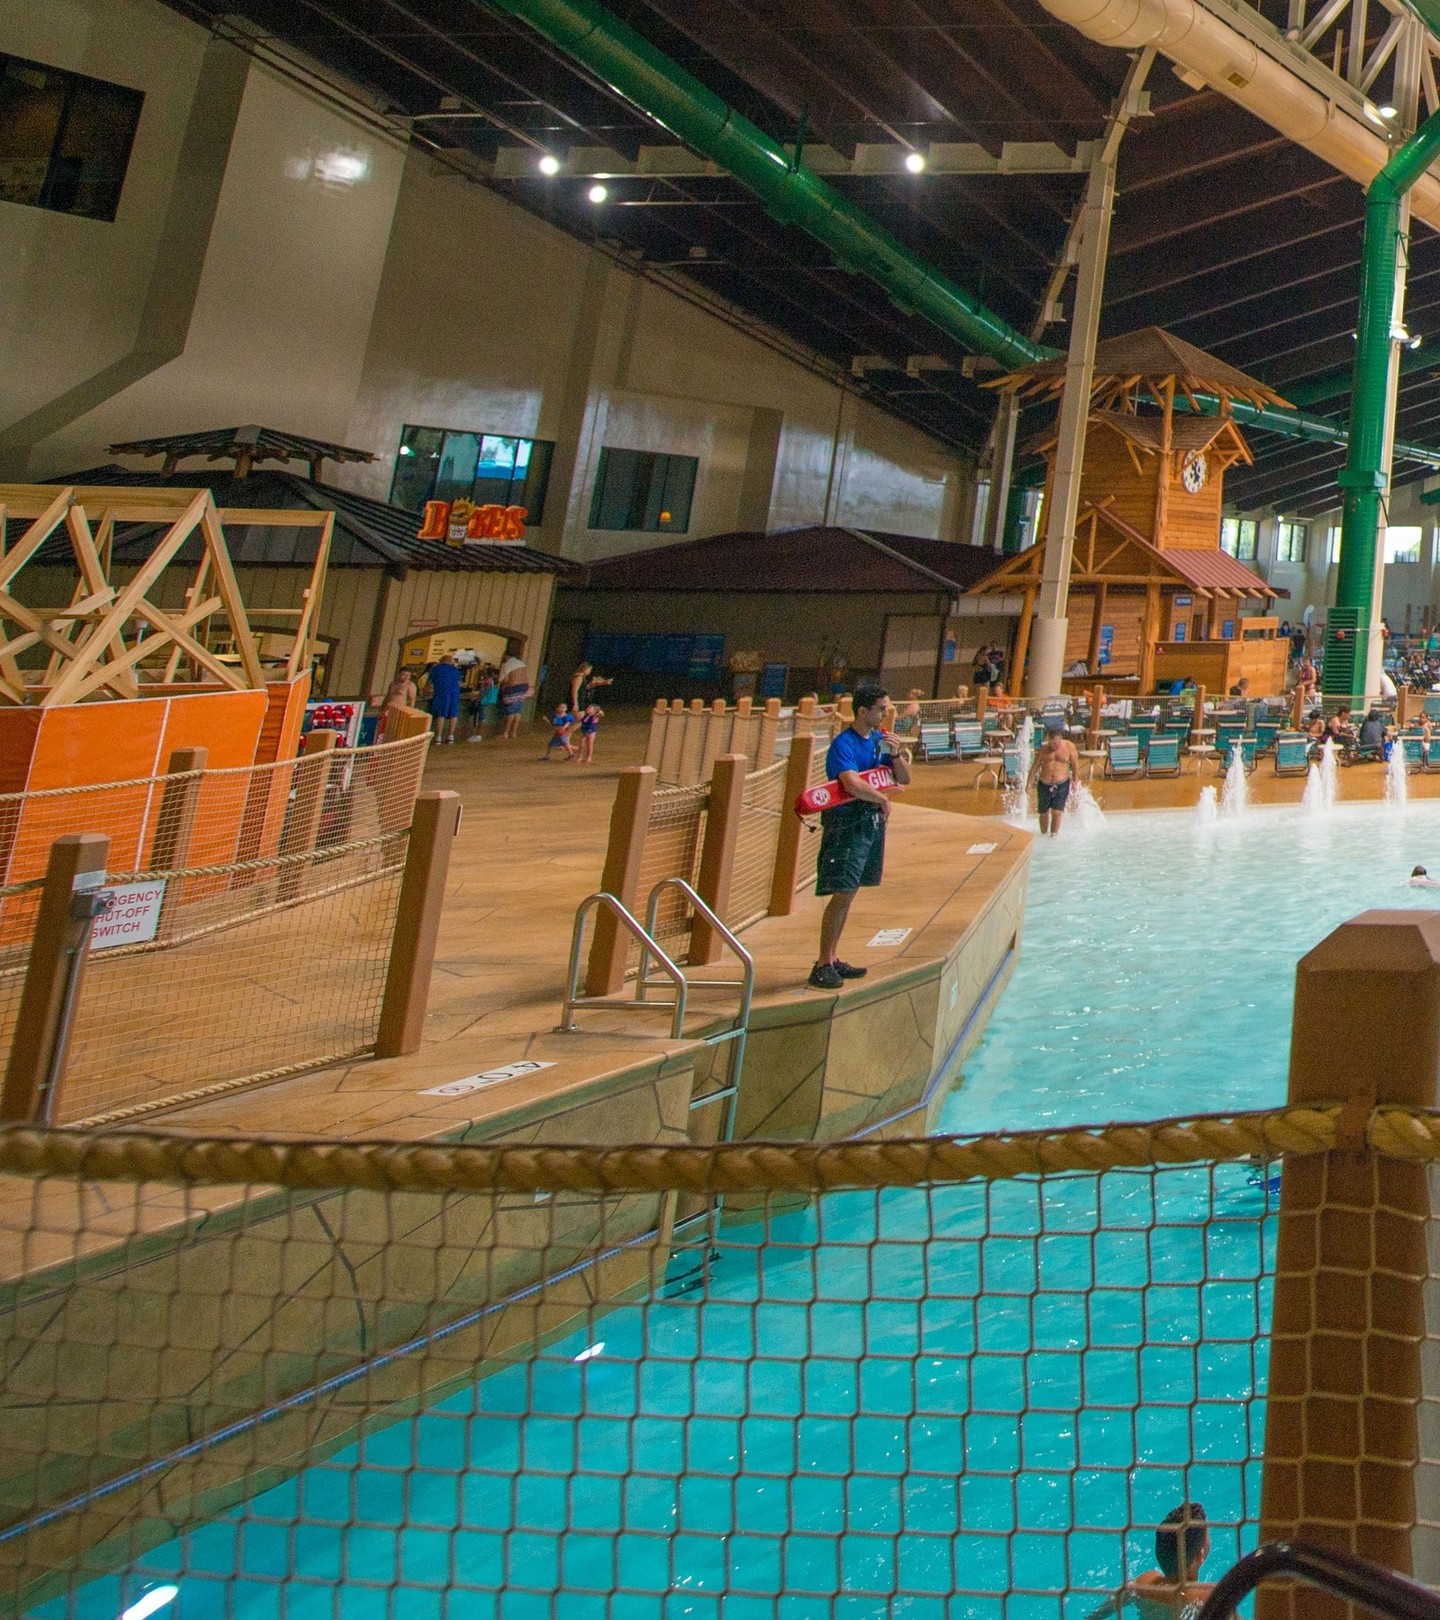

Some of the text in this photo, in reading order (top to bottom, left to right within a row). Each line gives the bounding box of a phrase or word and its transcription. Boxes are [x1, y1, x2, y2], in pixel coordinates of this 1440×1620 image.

[868, 769, 894, 789] GUA
[95, 905, 151, 923] HUT-OFF
[91, 921, 140, 939] SWITCH
